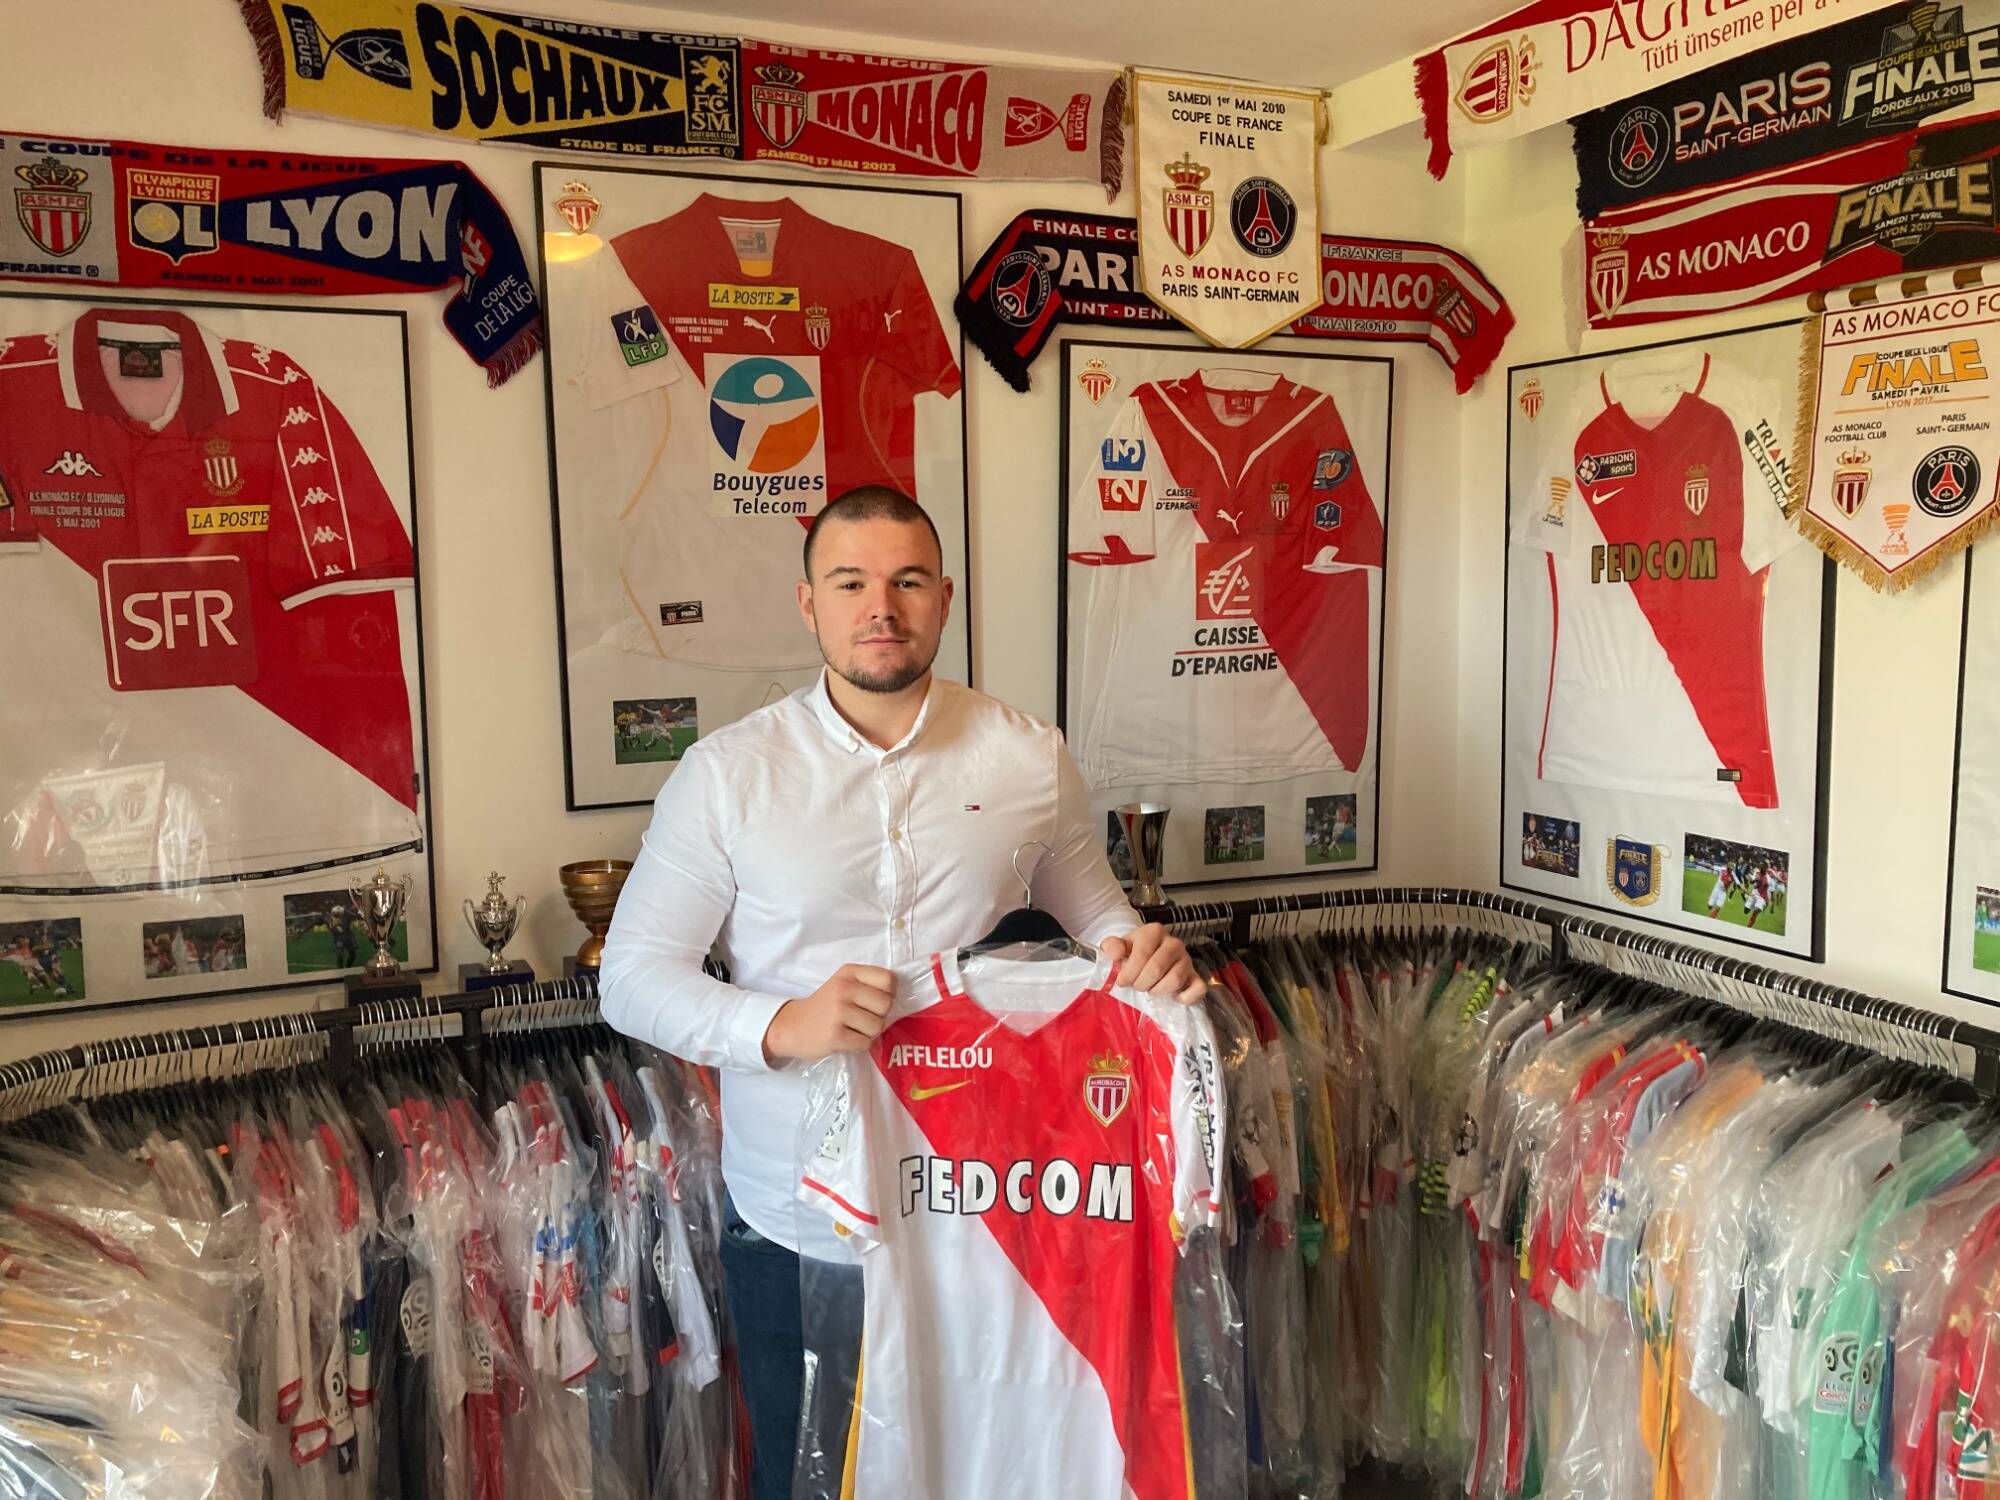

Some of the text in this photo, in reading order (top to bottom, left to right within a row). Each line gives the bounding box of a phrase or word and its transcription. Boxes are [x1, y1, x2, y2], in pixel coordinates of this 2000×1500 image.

[291, 17, 314, 66] LIGUE
[522, 18, 945, 72] FINALE COUPE DE LA LIGUE
[1641, 11, 1764, 72] Tüti ünseme
[1878, 51, 1916, 71] COUPE
[1934, 37, 1968, 54] LIGUE
[415, 2, 671, 130] SOCHAUX
[1842, 27, 2000, 120] FINALE
[694, 94, 728, 114] FC
[756, 87, 804, 105] ASM FC
[1168, 90, 1286, 114] SAMEDI 1er MAI 2010
[1673, 61, 1831, 143] PARIS
[1872, 90, 1940, 118] BORDEAUX
[1942, 82, 1973, 98] 2018
[692, 113, 732, 132] SM
[816, 71, 988, 171] MONACO
[1076, 103, 1087, 141] LIGUE
[1172, 109, 1283, 132] COUPE DE FRANCE
[1619, 110, 1658, 134] PARIS
[1200, 132, 1255, 150] FINALE
[1676, 103, 1832, 161] SAINT-GERMAIN
[560, 138, 721, 156] STADE DE FRANCE
[756, 148, 896, 172] SAMEDI 17 MAI 2003
[134, 174, 214, 190] OLYMPIQUE
[1868, 177, 1906, 196] COUPE
[1925, 167, 1957, 181] LIGUE
[136, 185, 211, 201] LYONNAIS
[1168, 193, 1211, 206] ASM FC
[1829, 161, 1993, 250] FINALE
[134, 202, 215, 248] OL
[246, 183, 458, 263] LYON
[1032, 219, 1107, 239] FINALE
[1874, 216, 1909, 231] SAMEDI
[1920, 211, 1944, 221] AVRIL
[1879, 221, 1933, 240] LYON 2017
[1327, 245, 1403, 261] FRANCE
[1637, 221, 1810, 282] AS MONACO
[0, 260, 82, 274] FRANCE
[1162, 264, 1299, 284] AS MONACO FC
[481, 274, 519, 308] COUPE
[711, 289, 775, 306] LA POSTE
[1162, 284, 1300, 303] PARIS SAINT-GERMAIN
[1323, 269, 1434, 309] ONACO
[474, 314, 499, 341] DE
[492, 302, 515, 325] LA
[1320, 317, 1352, 330] MAI
[1354, 321, 1398, 332] 2010
[1832, 316, 1857, 337] AS
[1863, 299, 1969, 332] MONACO
[629, 341, 661, 361] LFP
[1878, 352, 1904, 361] COUPE
[1922, 345, 1949, 355] LIGUE
[1841, 339, 1988, 396] FINALE
[1871, 391, 1907, 401] SAMEDI
[1921, 385, 1950, 395] AVRIL
[1886, 399, 1911, 410] LYON
[1832, 421, 1882, 432] AS MONACO
[1941, 413, 1966, 422] PARIS
[1825, 431, 1887, 443] FOOTBALL CLUB
[1916, 422, 1990, 435] SAINT-GERMAIN
[1600, 452, 1634, 466] PARIONS
[1611, 463, 1633, 474] sport
[1927, 451, 1971, 469] PARIS
[713, 472, 824, 496] Bouygues
[1110, 479, 1140, 504] 2
[1166, 488, 1195, 497] CAISSE
[29, 506, 126, 517] FINALE COUPE DE LA LIGUE
[733, 498, 807, 514] Telecom
[1156, 502, 1200, 511] D'EPARGNE
[63, 518, 79, 528] MAI
[80, 519, 100, 529] 2001
[191, 510, 270, 530] LA POSTE
[1591, 537, 1718, 583] FEDCOM
[121, 588, 239, 651] SFR
[1194, 625, 1259, 647] CAISSE
[1171, 652, 1278, 677] D'EPARGNE
[888, 1044, 994, 1070] AFFLELOU
[900, 1155, 1135, 1223] FEDCOM
